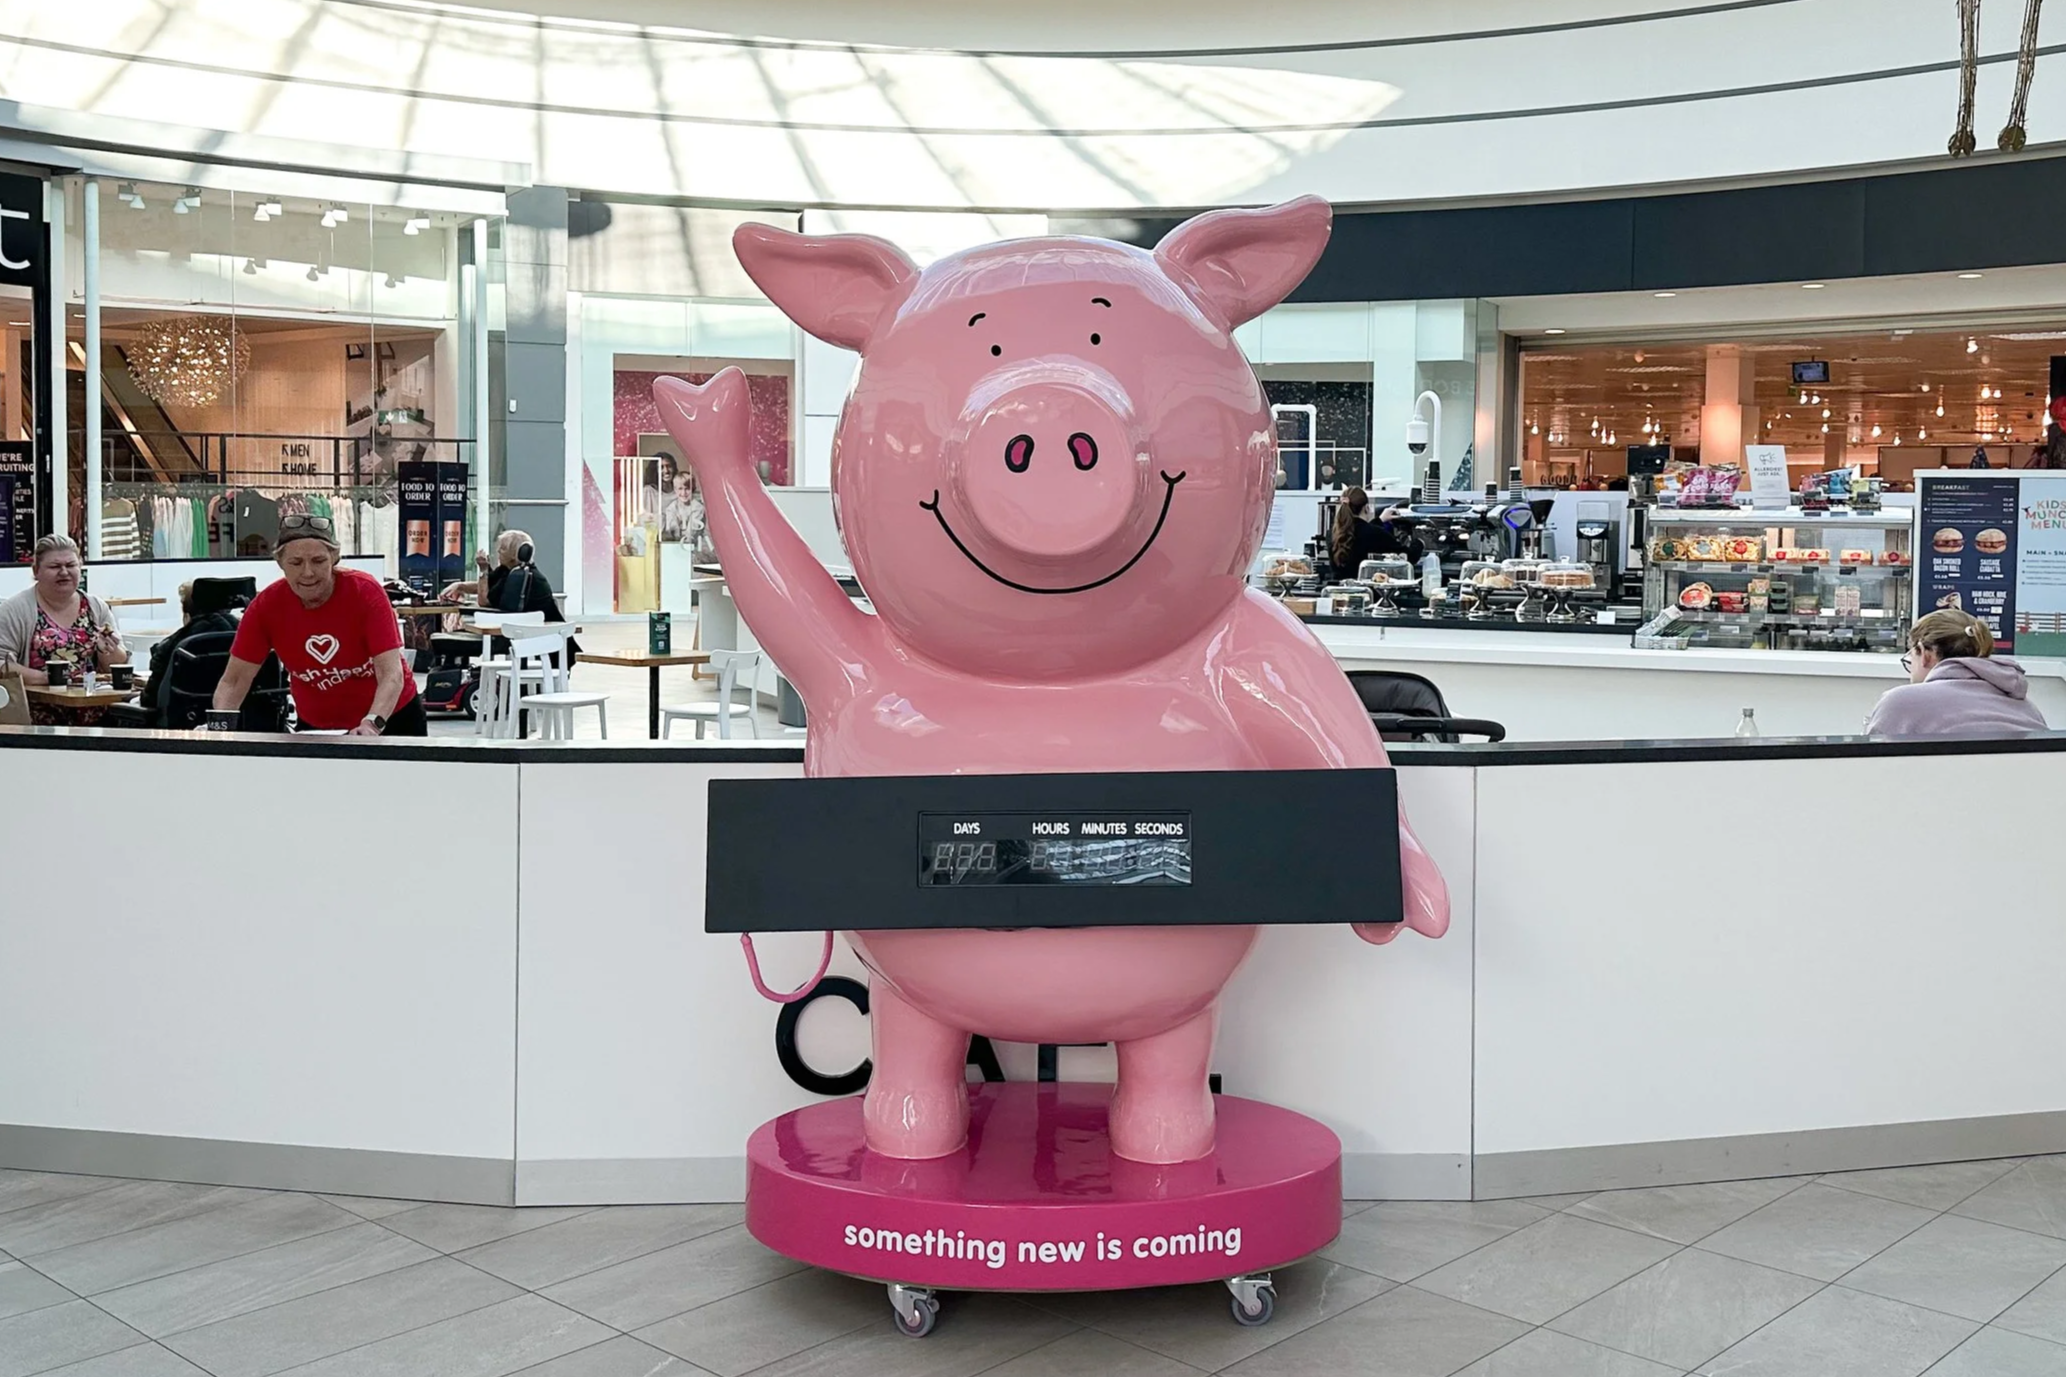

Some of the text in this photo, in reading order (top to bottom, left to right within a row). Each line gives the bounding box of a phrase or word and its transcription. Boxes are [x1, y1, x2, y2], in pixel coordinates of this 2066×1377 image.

[290, 444, 310, 457] MEN
[0, 453, 22, 462] E'RE
[290, 463, 317, 476] HOME
[401, 482, 435, 492] FOOD TO
[440, 483, 457, 492] FOOD
[405, 492, 431, 501] ORDER
[442, 493, 463, 502] ORDER
[208, 721, 228, 731] M&S
[953, 822, 1184, 835] DAYS HOURS MINUTES SECONDS
[843, 1224, 1242, 1269] something new is coming
